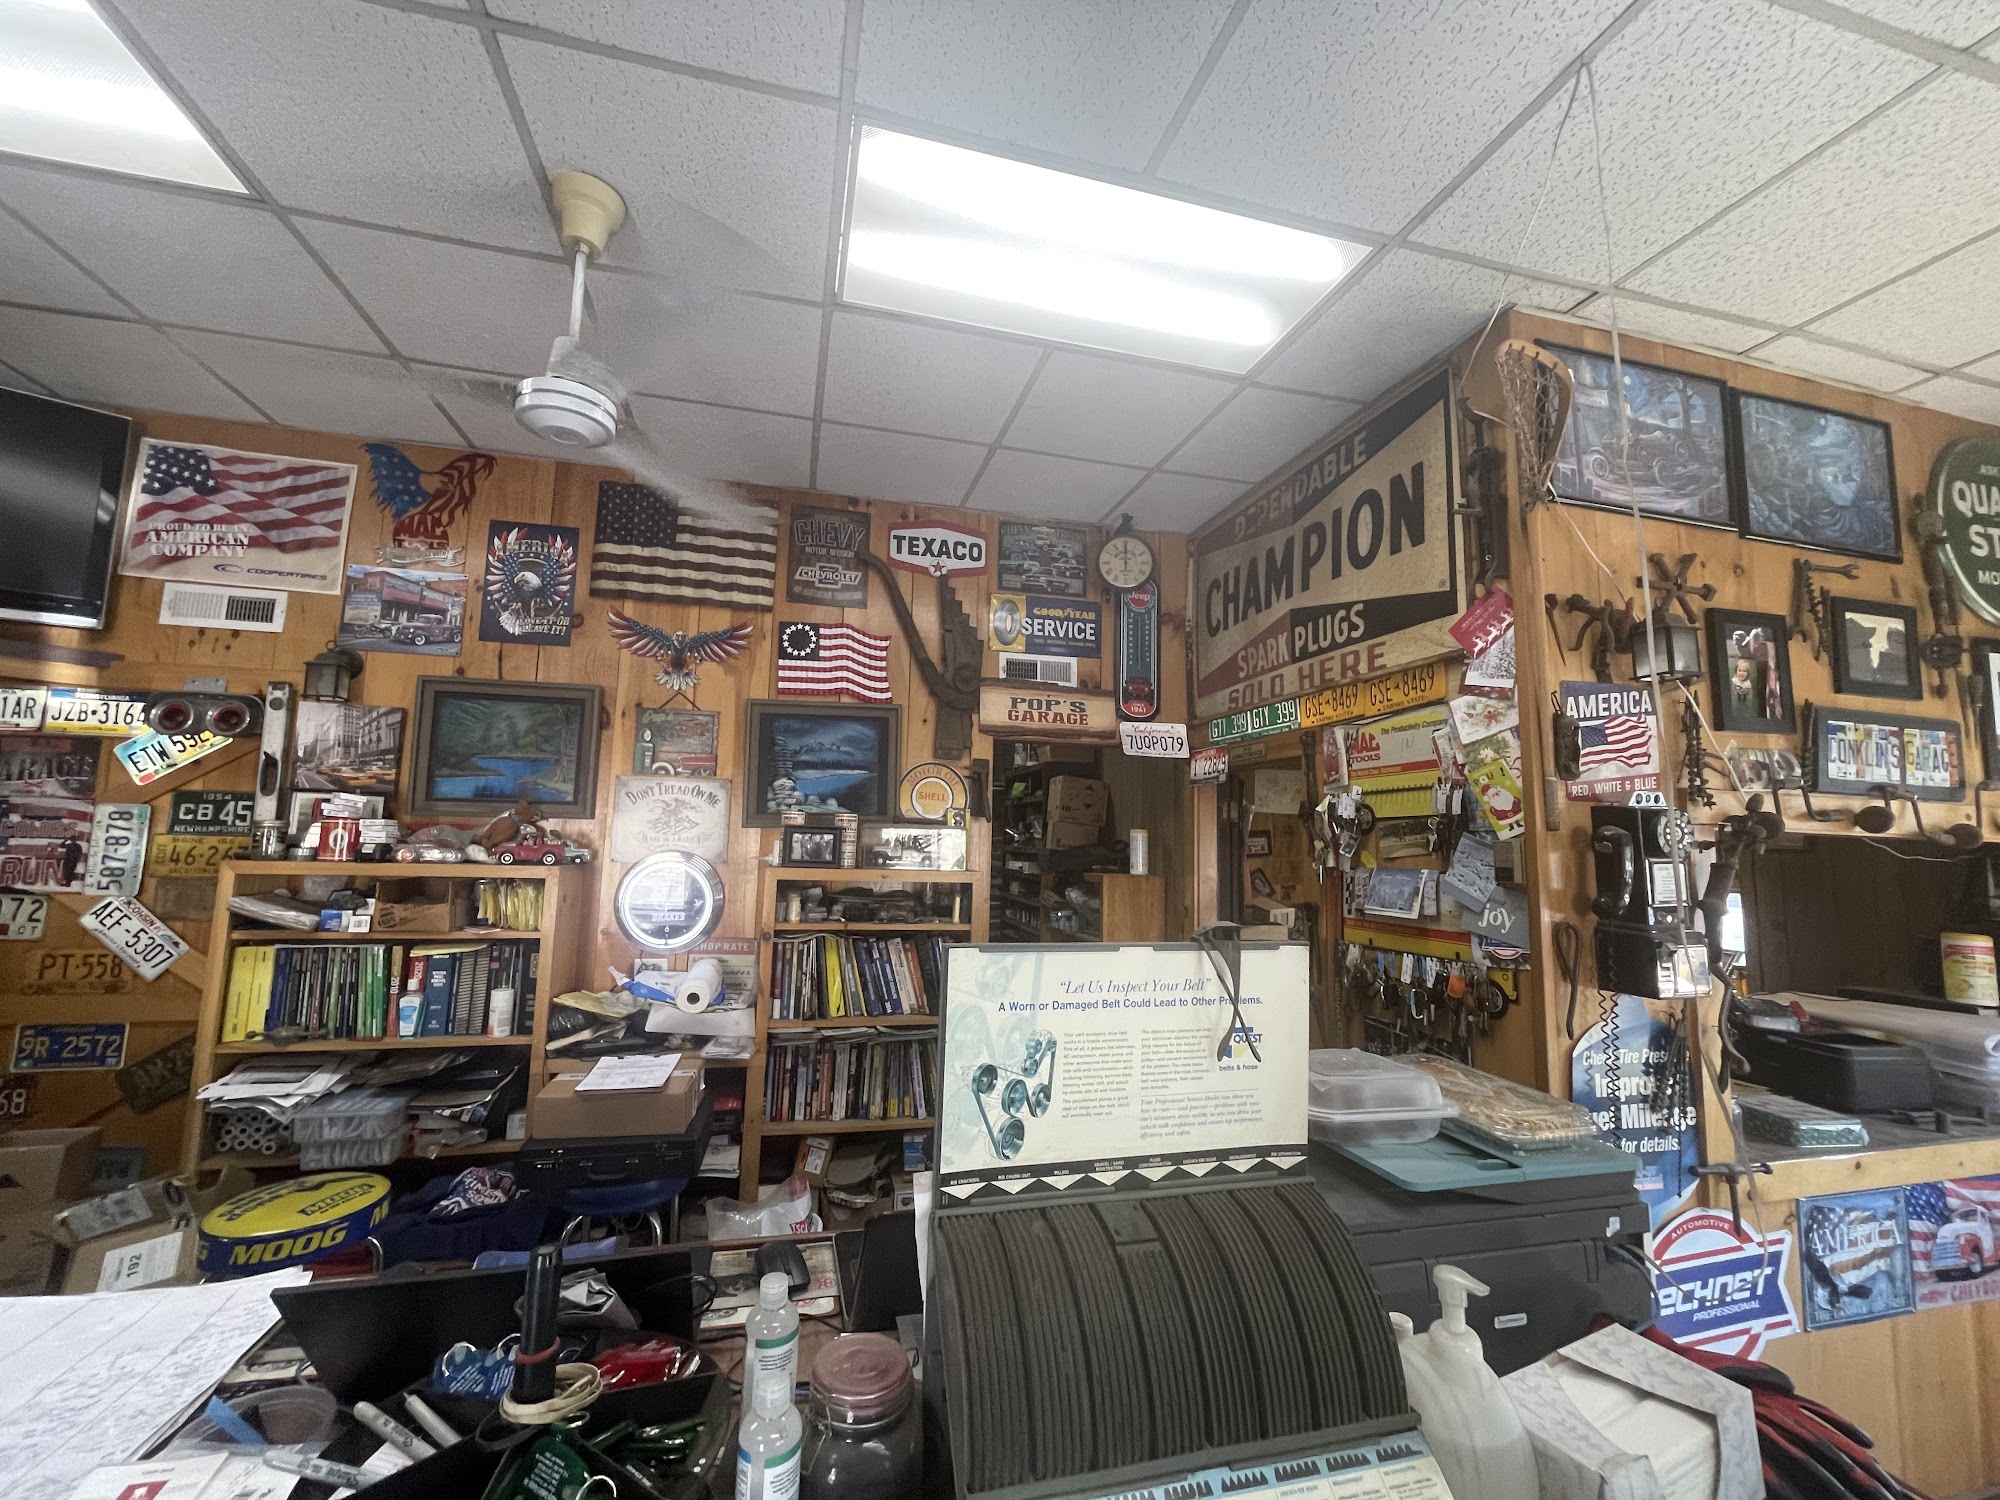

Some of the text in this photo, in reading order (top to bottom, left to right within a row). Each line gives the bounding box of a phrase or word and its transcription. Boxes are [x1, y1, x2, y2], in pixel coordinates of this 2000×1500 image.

[1234, 430, 1367, 542] DEPENDABLE
[150, 522, 188, 532] PROUD
[194, 523, 211, 532] TO
[213, 524, 226, 532] BE
[794, 519, 866, 551] CHEVY
[145, 531, 250, 546] AMERICAN
[893, 534, 984, 563] TEXACO
[151, 543, 249, 558] COMPANY
[805, 546, 828, 556] MOTOR
[1205, 461, 1426, 638] CHAMPION
[801, 569, 857, 582] CHEVROLET
[1128, 590, 1151, 602] Jeep
[1021, 617, 1097, 641] SERVICE
[1295, 603, 1366, 657] PLUGS
[1238, 633, 1290, 680] SPARK
[1227, 640, 1388, 711] SOLD HERE
[1370, 679, 1392, 706] GSE
[1010, 696, 1087, 714] POP'S
[1130, 705, 1146, 714] 1941
[1253, 701, 1297, 729] GTY 399
[1305, 695, 1325, 719] GSE
[1566, 690, 1653, 719] AMERICA
[1008, 709, 1089, 726] GARAGE
[1231, 717, 1248, 735] 399
[1381, 718, 1450, 735] The Productivity Company
[1133, 725, 1174, 736] California
[1126, 734, 1184, 753] 7UQP079
[127, 741, 170, 773] ETW
[1349, 753, 1381, 763] TOOLS
[907, 766, 960, 787] MOTOR OIL
[625, 781, 722, 809] DON'T TREAD ON ME
[917, 791, 947, 802] SHELL
[1571, 777, 1657, 798] RED, WHITE & BLUE
[179, 801, 254, 827] CB 45
[174, 824, 196, 833] NEW
[97, 810, 134, 891] 587-878
[0, 857, 67, 888] RUN
[651, 912, 686, 922] BRAKES
[1478, 903, 1516, 934] joy
[90, 901, 175, 969] AEF-5307
[664, 925, 670, 933] 6
[414, 961, 424, 980] 2020
[390, 976, 400, 994] 2010
[1088, 979, 1103, 994] Us
[1107, 978, 1148, 998] Inspect
[1152, 978, 1181, 993] Your
[998, 995, 1264, 1012] A Worn or Damaged Belt Could Lead to Other Prolems.
[1619, 1049, 1639, 1064] Tire
[1219, 1064, 1235, 1072] belts
[1621, 1135, 1681, 1154] for details.
[1671, 1219, 1732, 1241] AUTOMOTIVE
[1812, 1219, 1903, 1255] AMERICA
[229, 1222, 350, 1266] MOOG
[126, 1252, 143, 1279] 192
[1692, 1299, 1761, 1322] PROFESSIONAL
